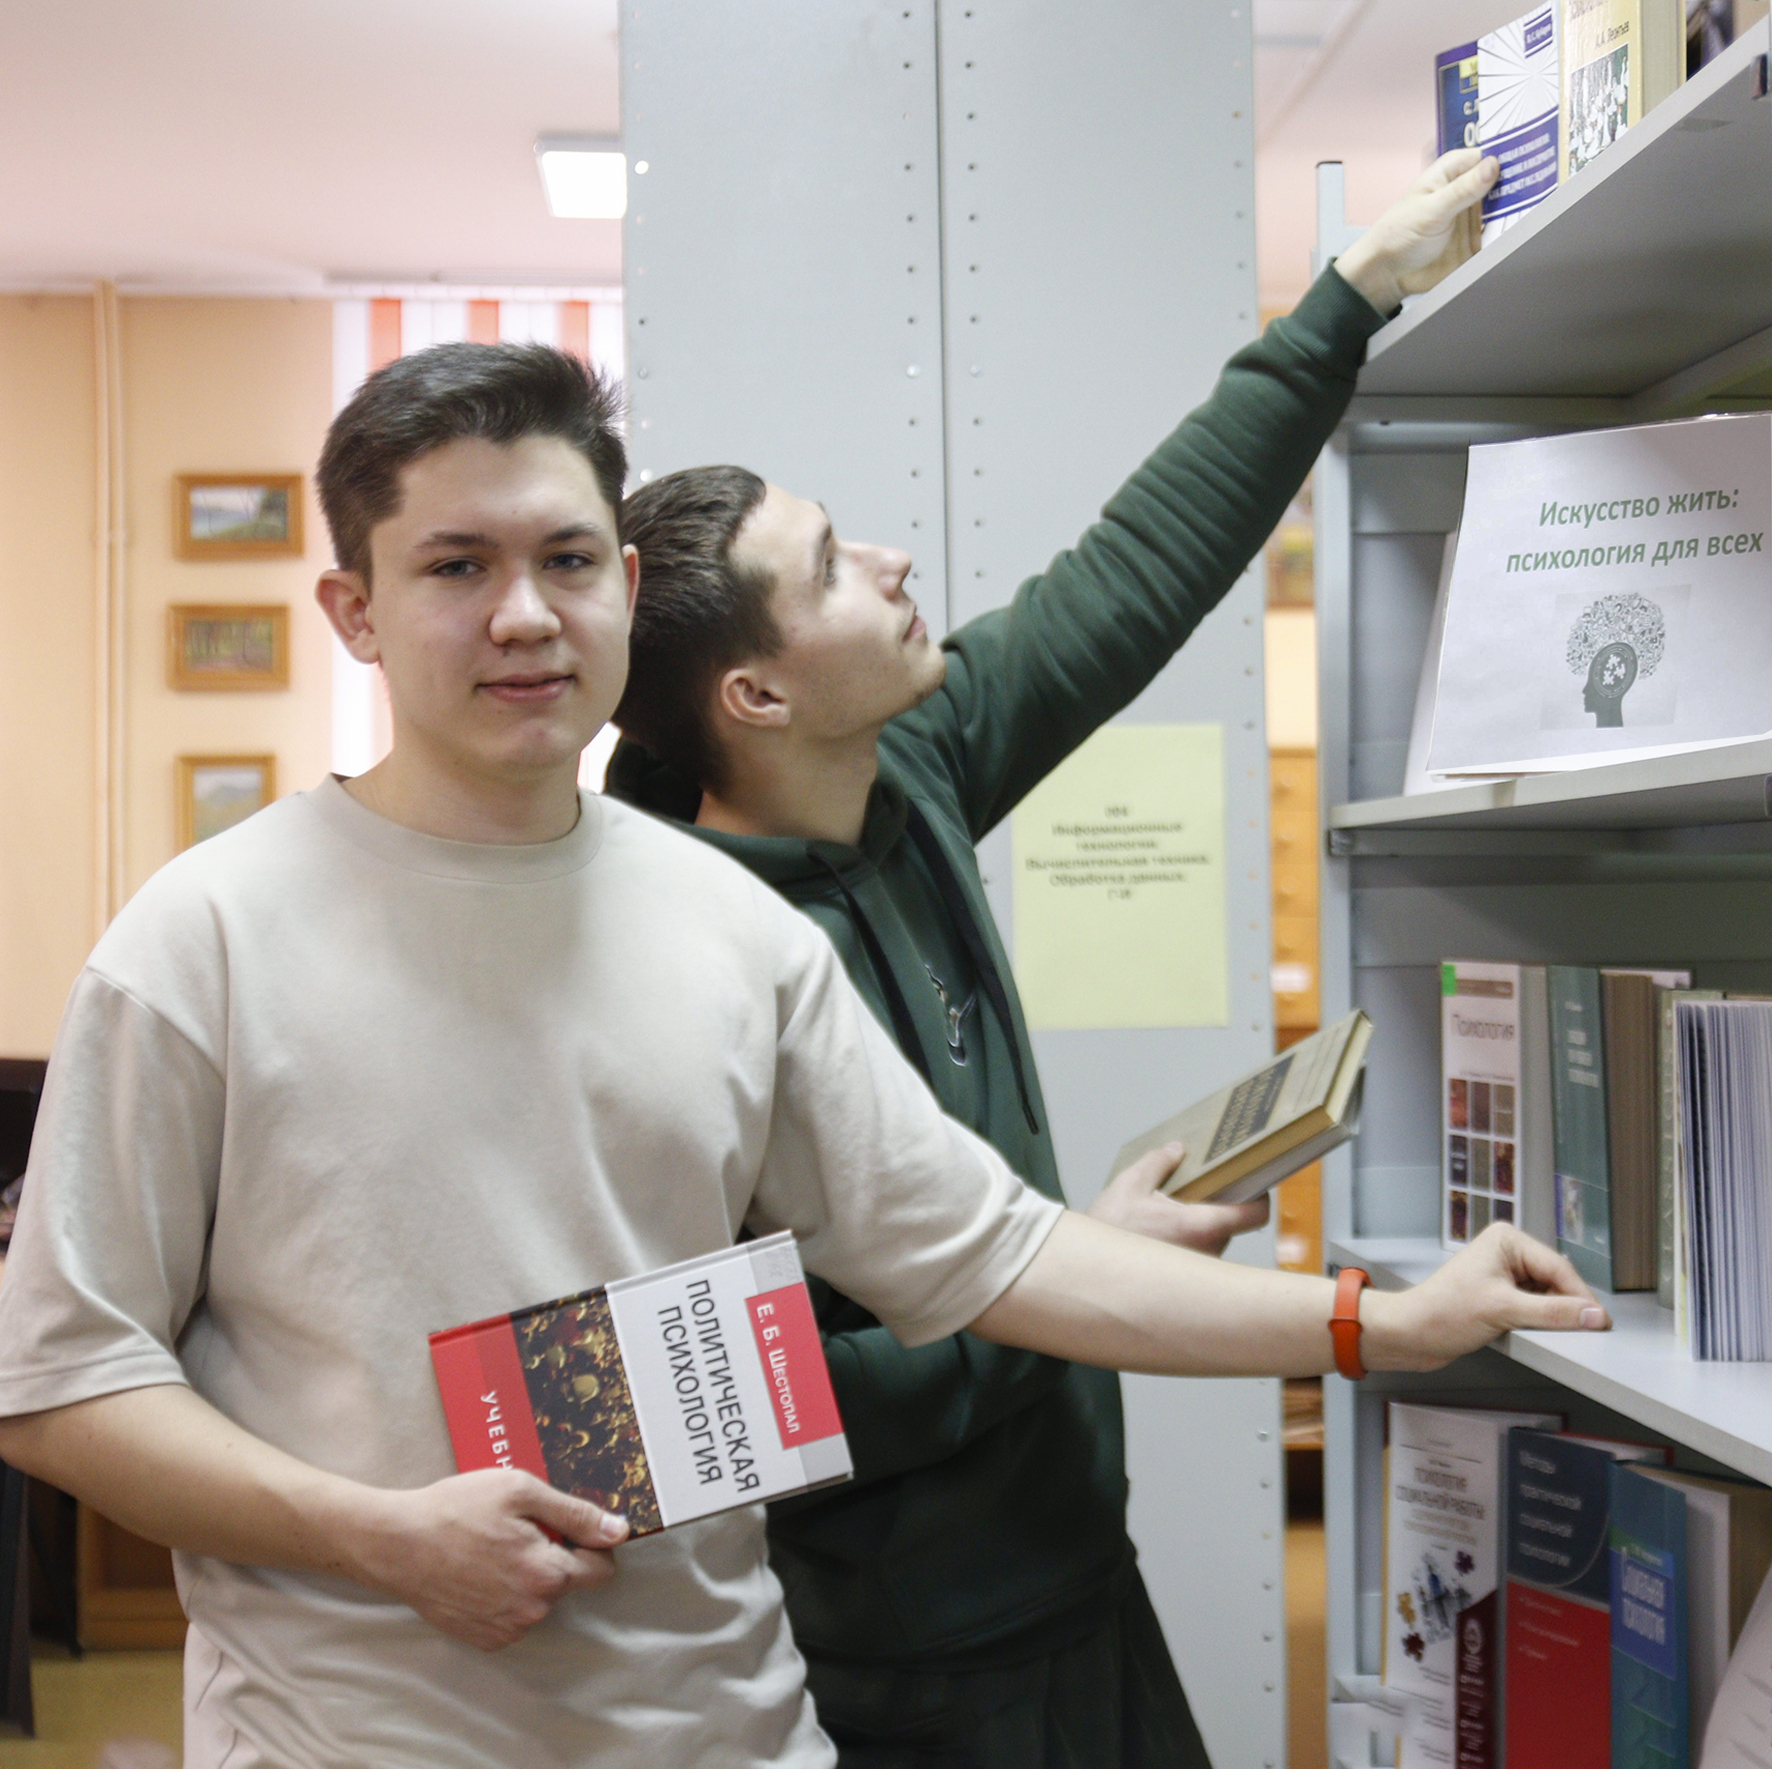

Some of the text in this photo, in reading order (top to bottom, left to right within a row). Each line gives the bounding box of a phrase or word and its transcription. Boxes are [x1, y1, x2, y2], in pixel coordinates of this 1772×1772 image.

[1539, 488, 1740, 528] Искусство жить:
[1506, 532, 1764, 573] психология для всех
[756, 1303, 775, 1324] Е.
[762, 1325, 781, 1347] Б.
[657, 1305, 723, 1486] ПСИХОЛОГИЯ
[687, 1279, 761, 1493] ПОЛИТИЧЕСКАЯ
[480, 1390, 514, 1470] УЧЕБН
